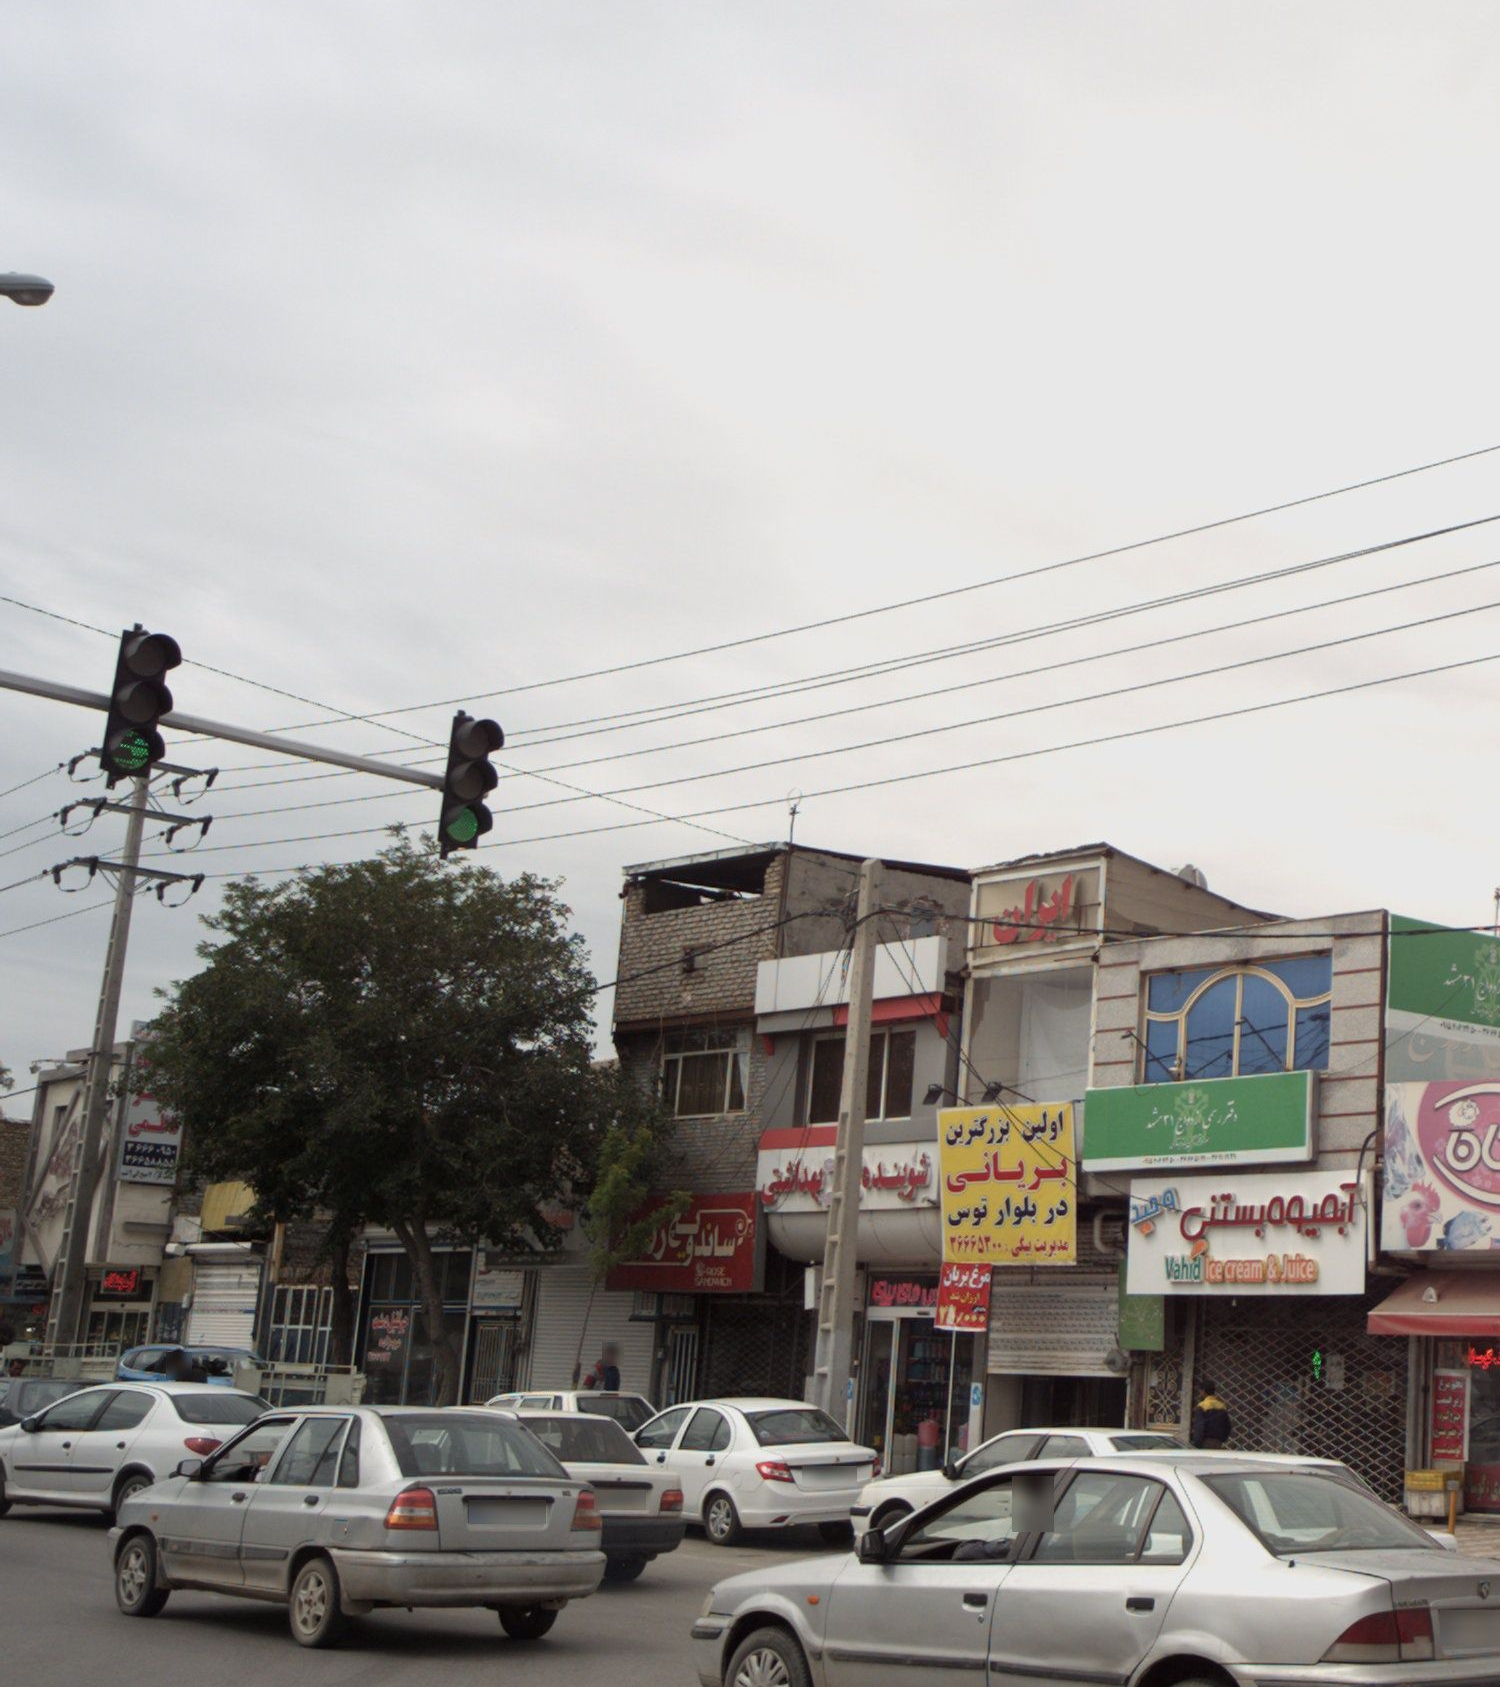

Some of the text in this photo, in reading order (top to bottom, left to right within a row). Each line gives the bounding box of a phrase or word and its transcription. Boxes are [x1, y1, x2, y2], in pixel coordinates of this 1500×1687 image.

[992, 872, 1074, 943] ایران
[946, 1111, 1064, 1145] اولین بزرگترین
[947, 1151, 1068, 1192] بریانی
[948, 1196, 1069, 1225] در بلوار توس
[1180, 1193, 1266, 1242] بستنی
[1165, 1254, 1317, 1282] Vahid Ice cream & Juice
